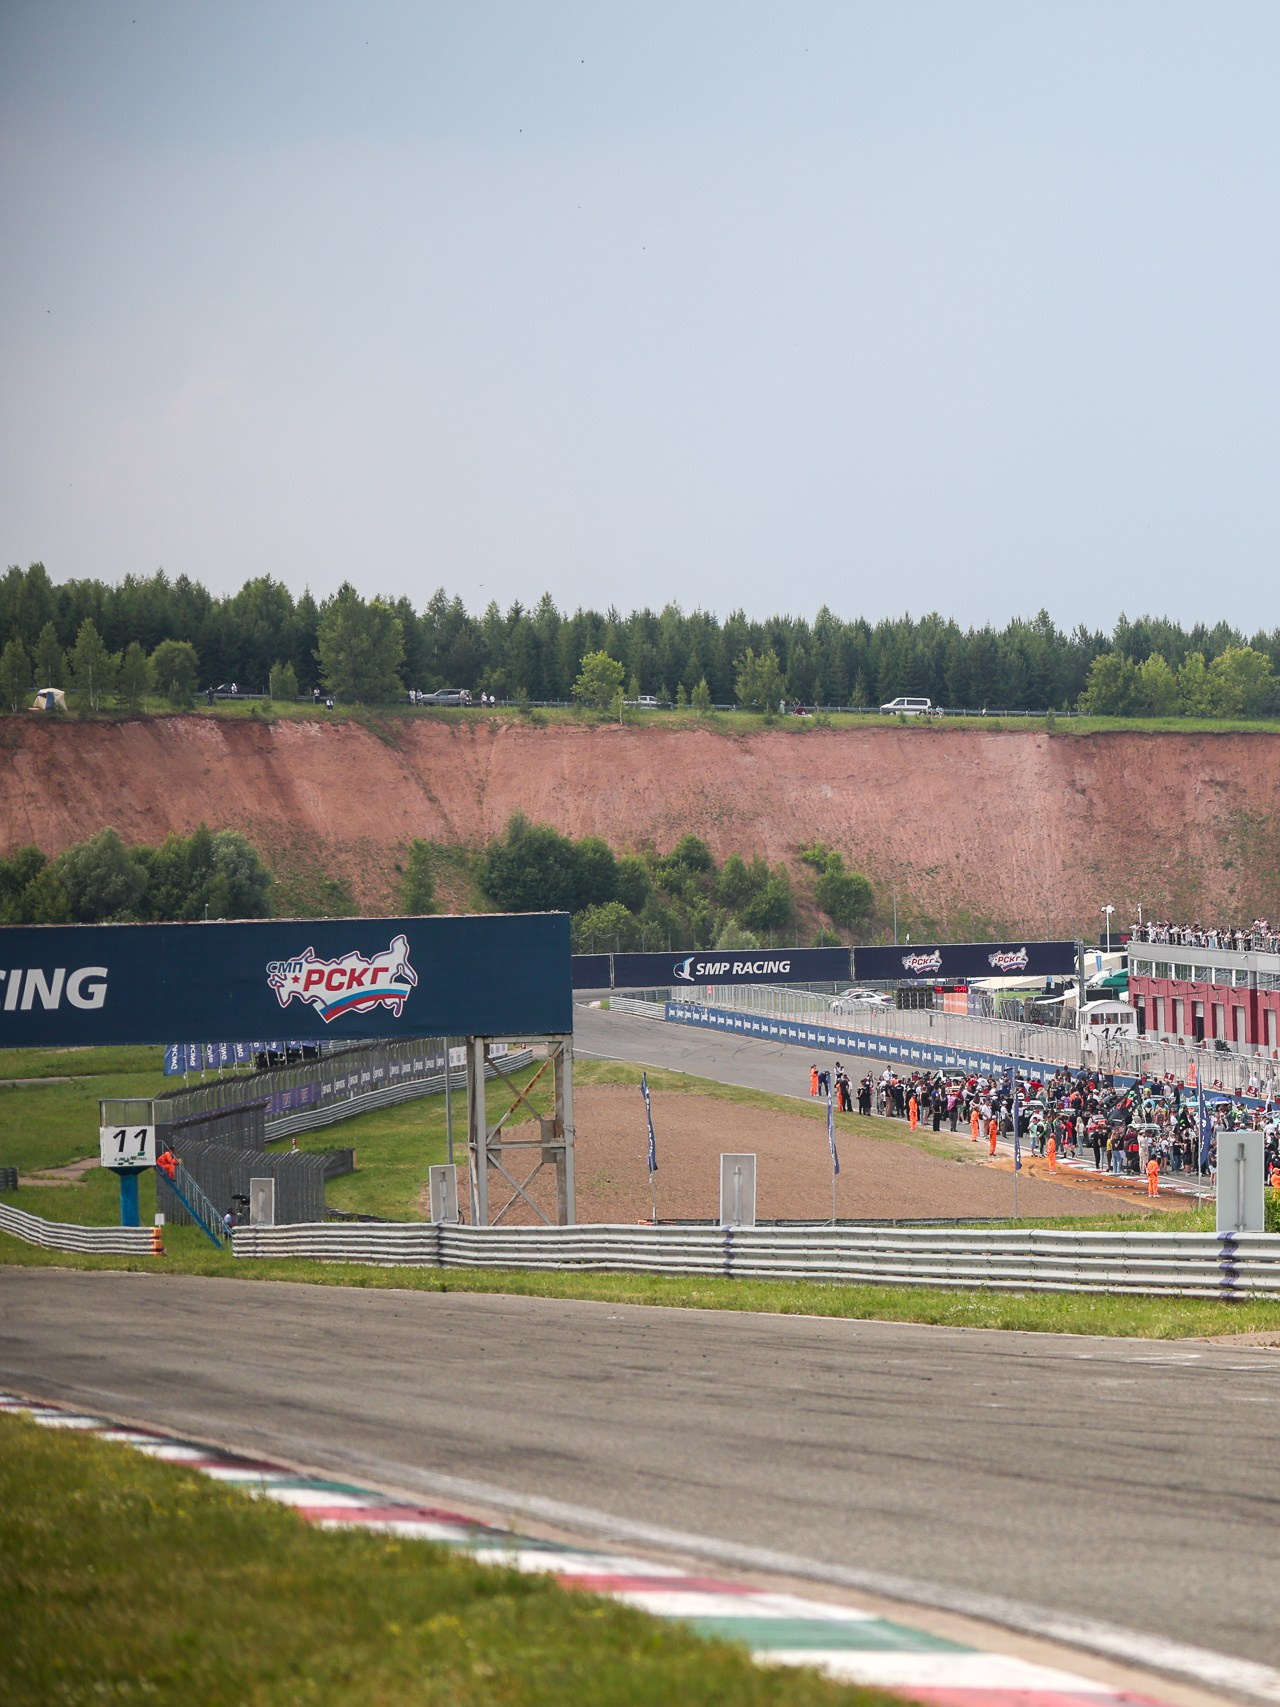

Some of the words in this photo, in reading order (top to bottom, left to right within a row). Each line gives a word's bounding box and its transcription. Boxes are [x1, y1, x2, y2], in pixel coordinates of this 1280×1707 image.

[267, 961, 303, 974] СМП
[695, 962, 730, 975] SMP
[732, 960, 791, 974] RACING
[911, 958, 935, 966] РСКГ
[997, 956, 1021, 964] РСКГ
[303, 966, 389, 992] РСКГ
[0, 966, 108, 1011] ING
[113, 1129, 147, 1152] 11
